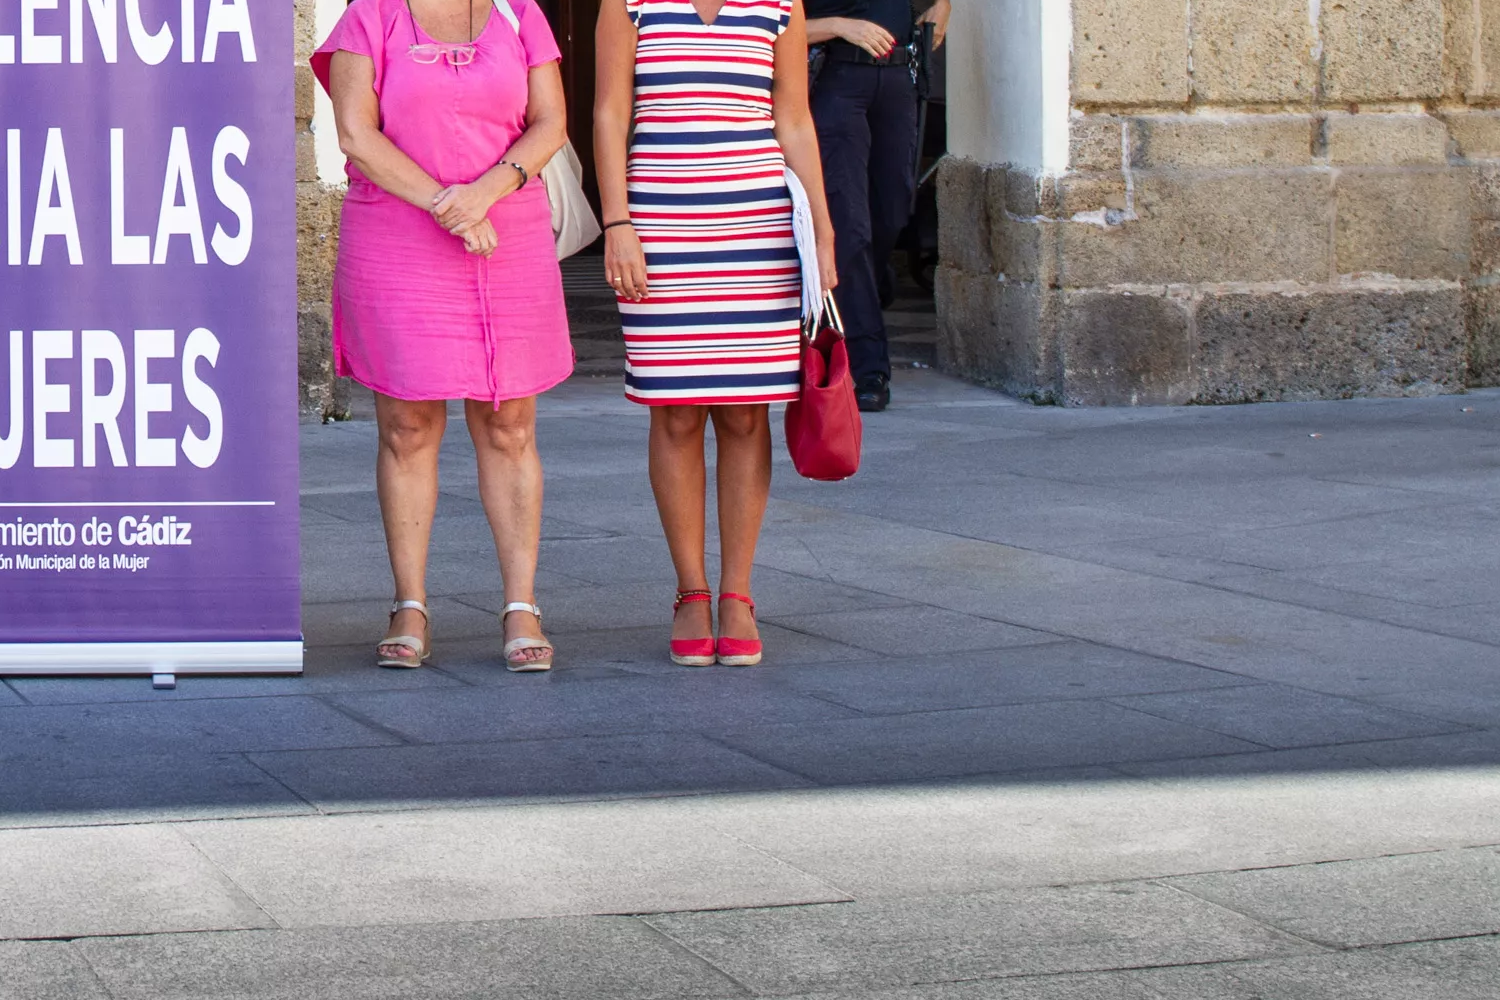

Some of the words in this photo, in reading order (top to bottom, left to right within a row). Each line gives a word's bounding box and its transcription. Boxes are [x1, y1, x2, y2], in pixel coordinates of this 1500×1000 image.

[110, 125, 253, 266] LAS
[81, 516, 112, 546] de
[118, 515, 192, 546] Cádiz
[16, 553, 76, 572] Municipal
[79, 554, 95, 569] de
[98, 554, 110, 569] la
[113, 553, 150, 572] Mujer
